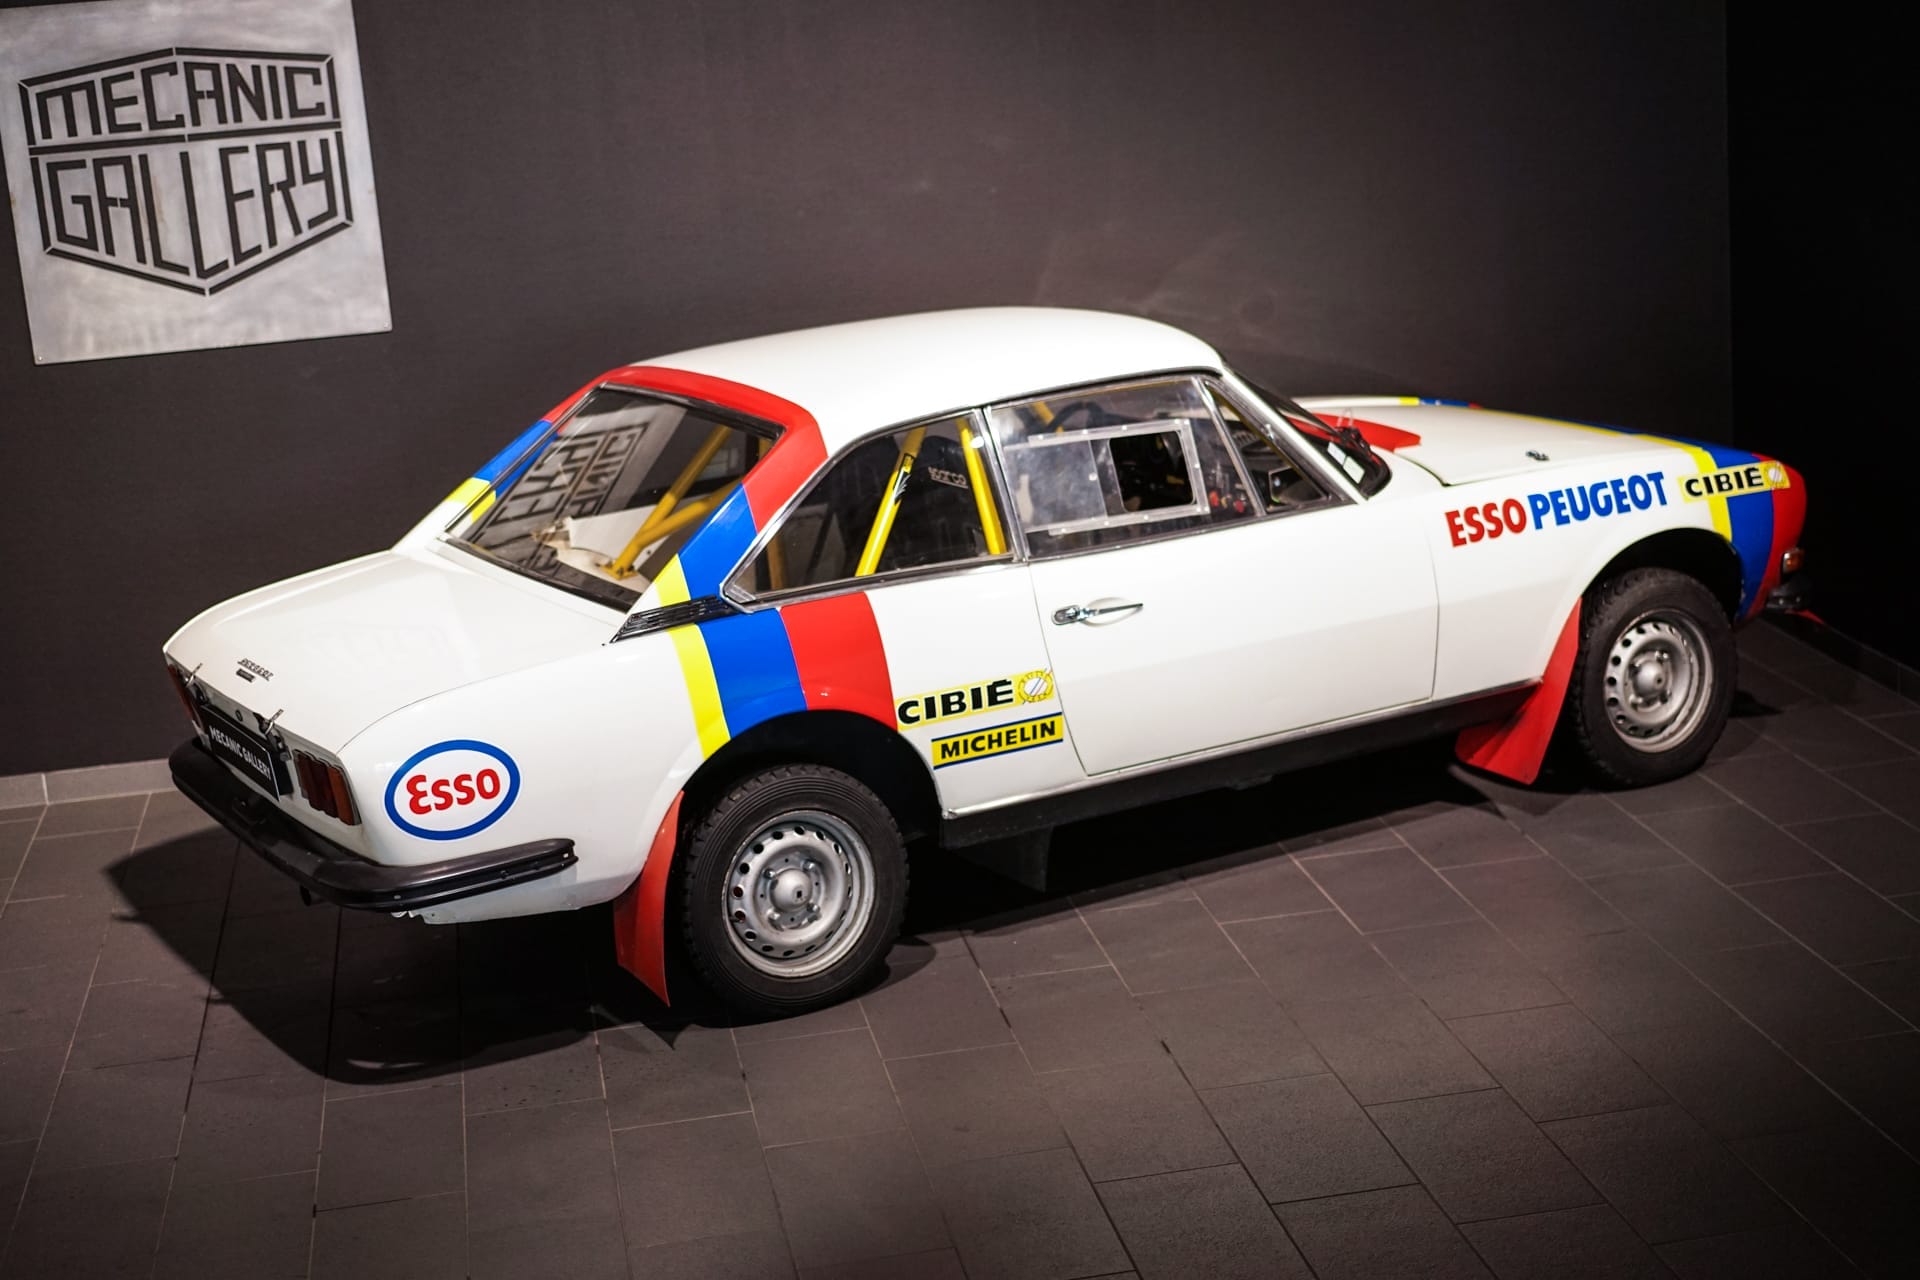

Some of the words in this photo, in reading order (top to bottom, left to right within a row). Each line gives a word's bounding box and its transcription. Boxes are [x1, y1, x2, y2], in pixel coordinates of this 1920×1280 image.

[35, 61, 327, 140] MECANIC
[46, 138, 338, 280] GALLERY
[1445, 498, 1528, 548] ESSO
[1527, 471, 1668, 530] PEUGEOT
[209, 724, 243, 758] MECANIC
[242, 747, 271, 781] GALLERY
[941, 720, 1056, 760] MICHELIN
